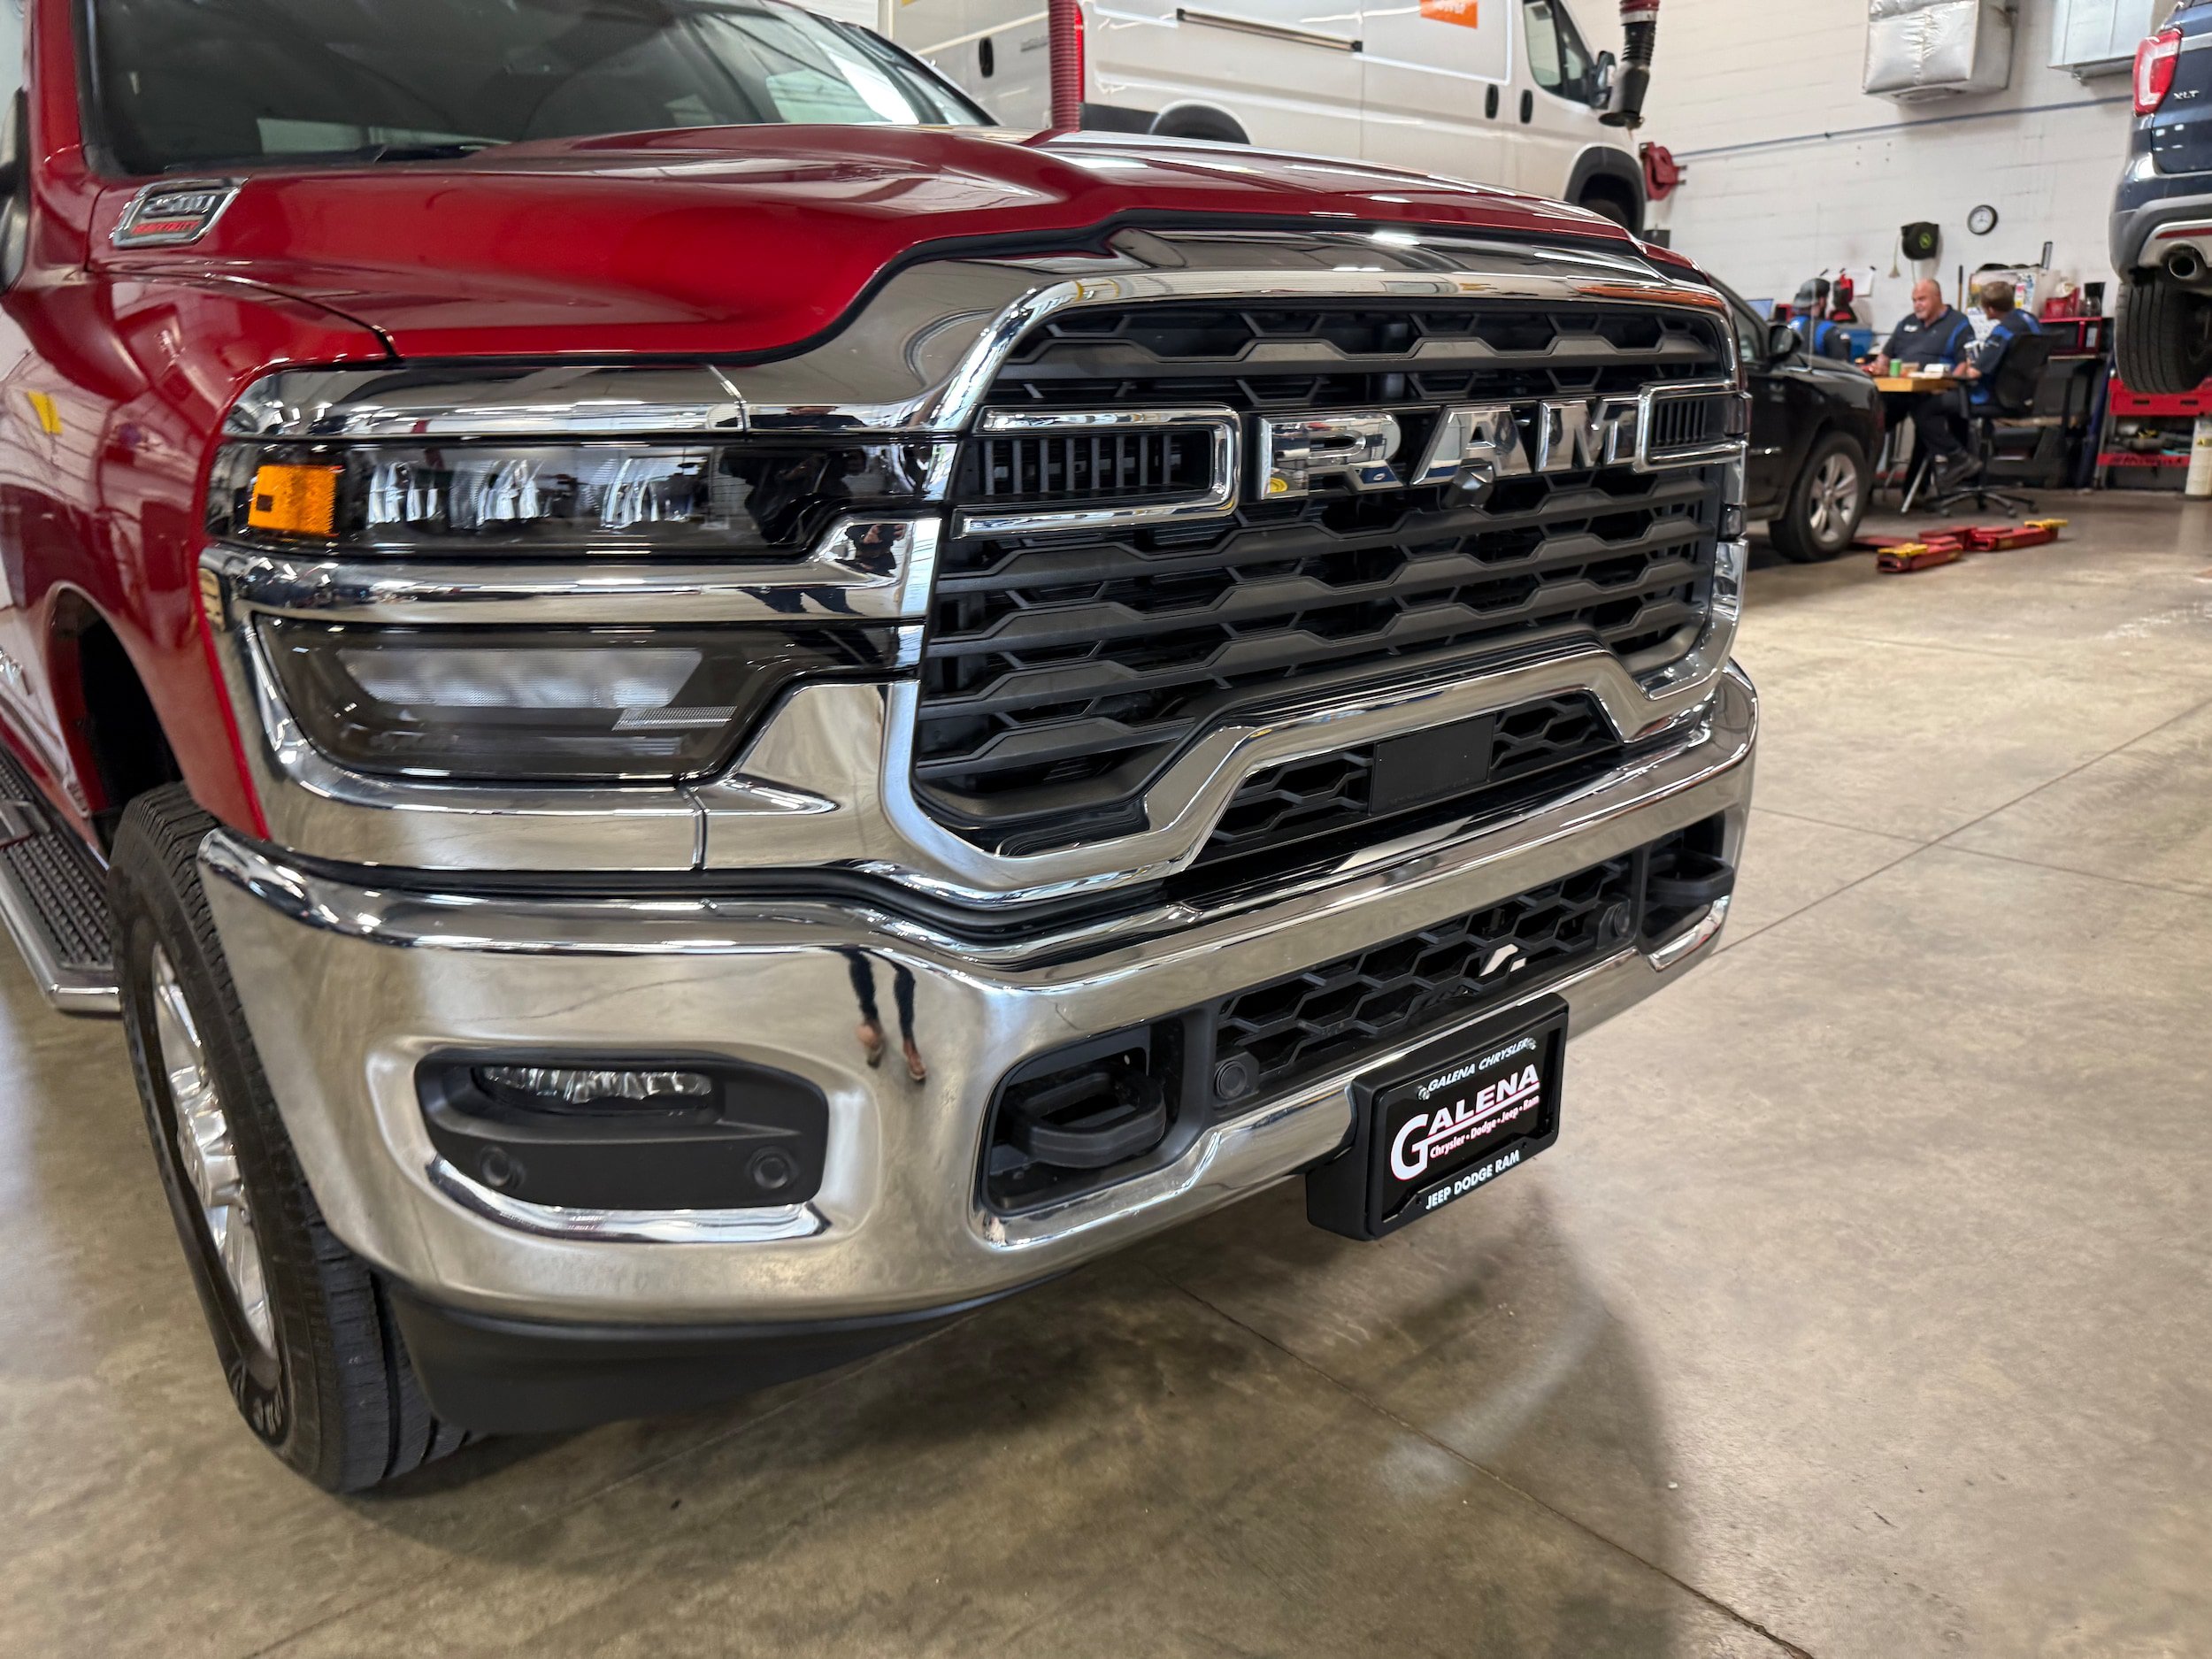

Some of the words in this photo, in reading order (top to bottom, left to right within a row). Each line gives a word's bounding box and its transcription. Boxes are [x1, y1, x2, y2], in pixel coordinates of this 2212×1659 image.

[2173, 89, 2200, 100] XLT
[1259, 396, 1639, 501] RAM
[1428, 1064, 1476, 1093] GALENA
[1479, 1037, 1530, 1071] CHRYSLER
[1390, 1064, 1540, 1181] GALENA
[1430, 1134, 1465, 1159] Chrysler
[1470, 1118, 1497, 1140] Dodge
[1500, 1108, 1519, 1124] Jeep
[1523, 1095, 1540, 1111] Ram
[1425, 1186, 1452, 1210] JEEP
[1454, 1164, 1493, 1195] DODGE
[1495, 1149, 1520, 1173] RAM
